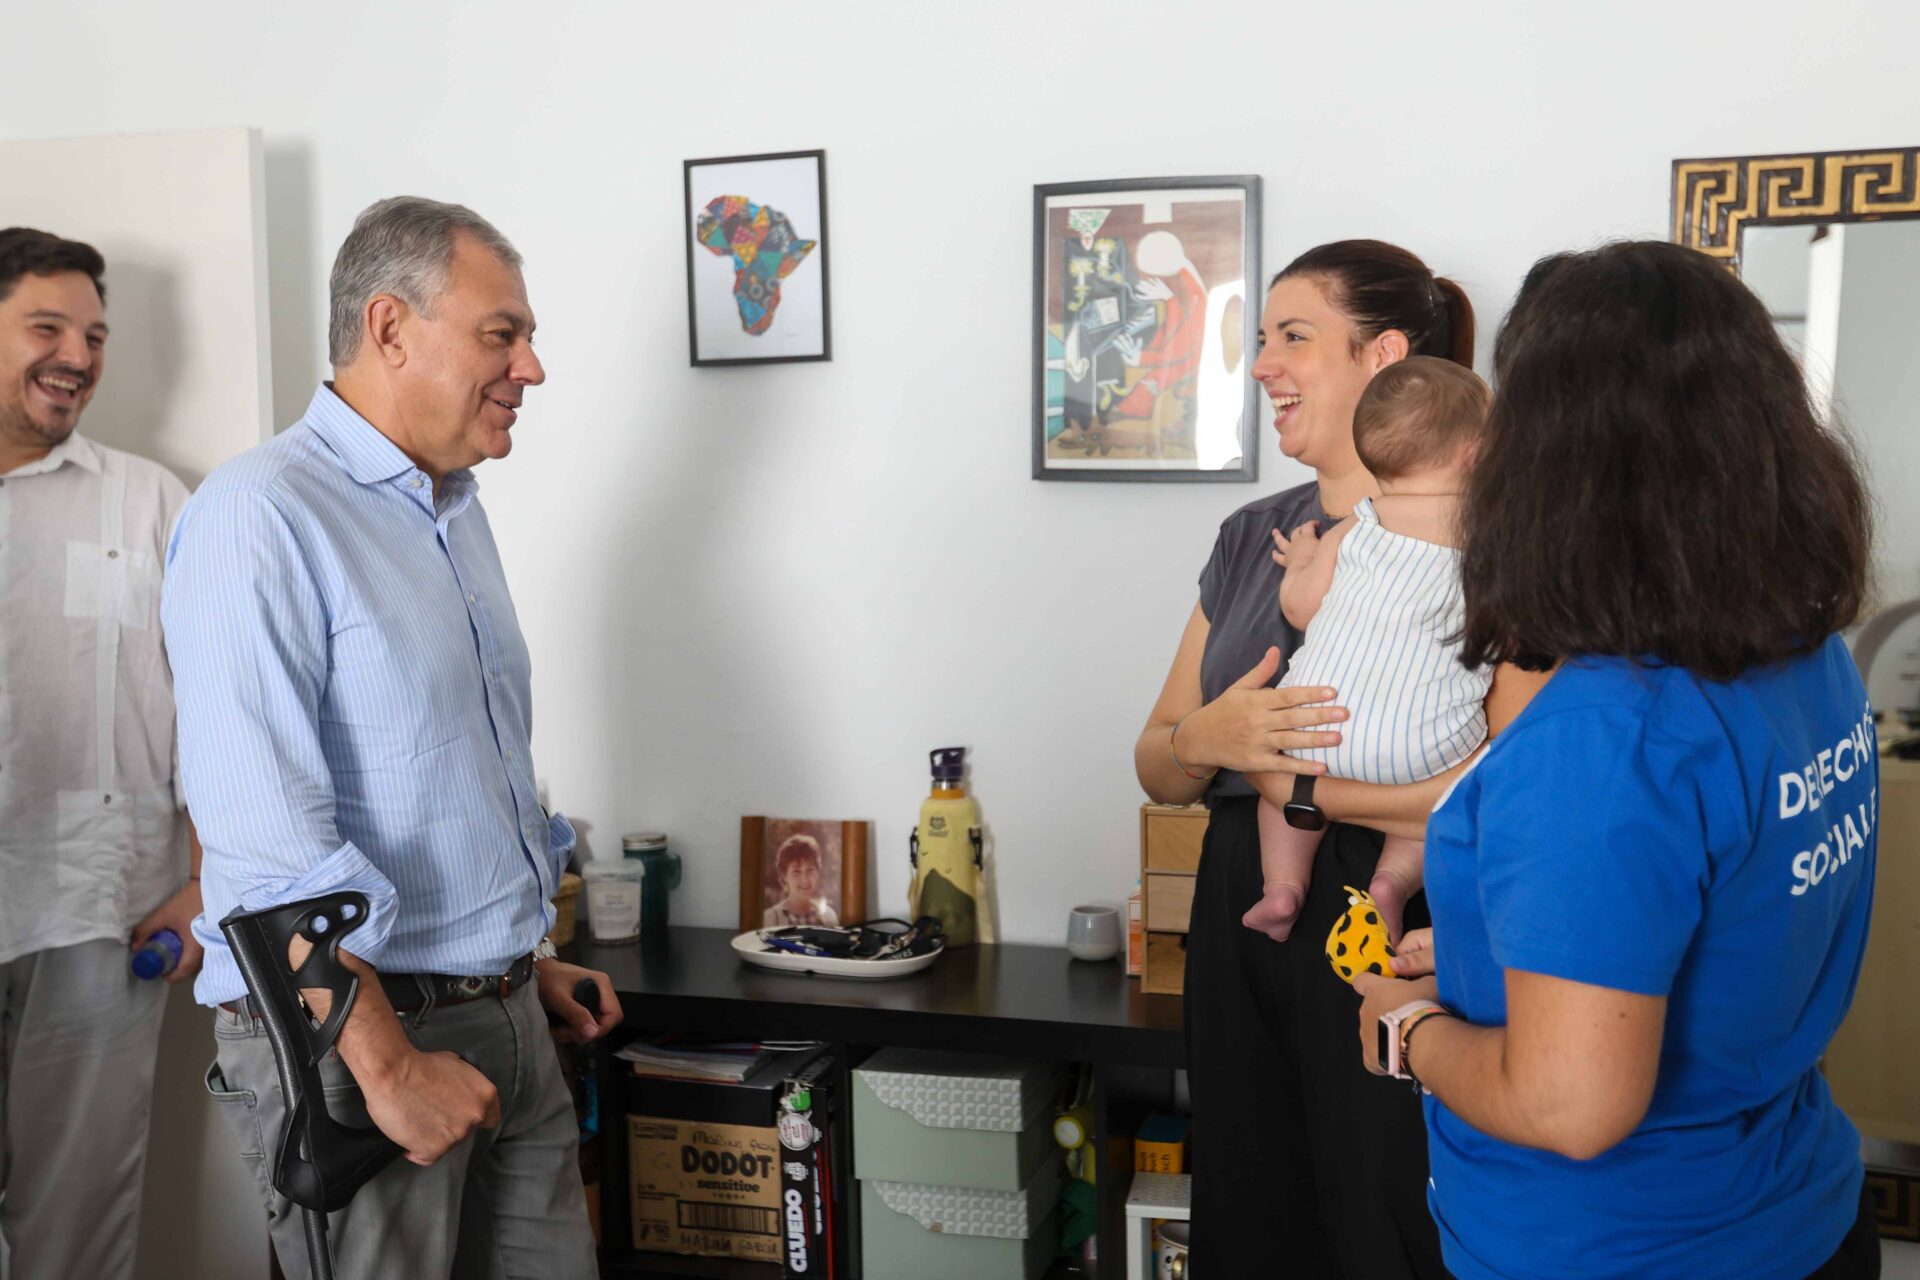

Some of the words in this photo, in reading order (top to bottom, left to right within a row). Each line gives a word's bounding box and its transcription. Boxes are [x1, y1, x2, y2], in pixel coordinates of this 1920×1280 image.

[681, 1145, 772, 1178] DODOT
[697, 1179, 760, 1193] sensitive
[784, 1189, 808, 1273] CLUEDO
